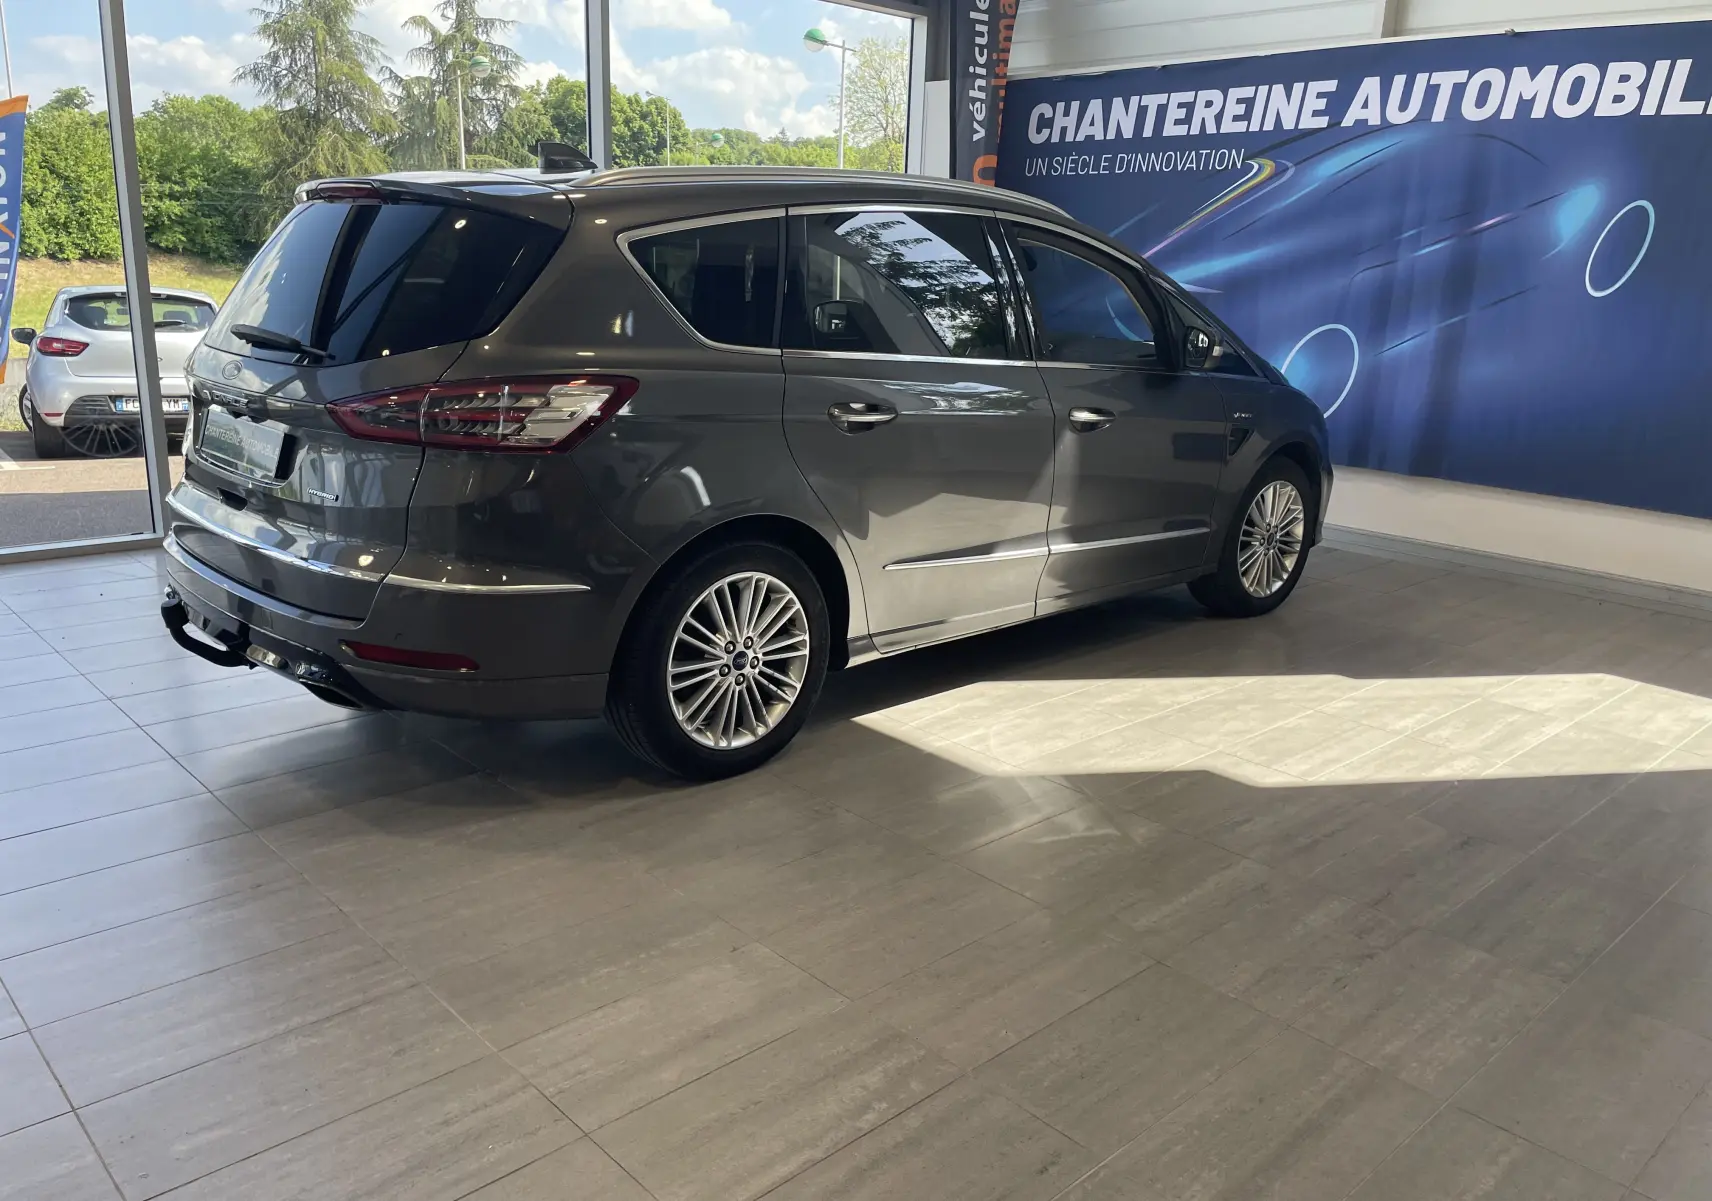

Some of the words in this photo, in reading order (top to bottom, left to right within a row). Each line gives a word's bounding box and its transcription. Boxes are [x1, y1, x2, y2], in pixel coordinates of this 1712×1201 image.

[1027, 79, 1338, 145] CHANTEREINE
[1340, 58, 1712, 127] AUTOMOBIL
[1025, 157, 1048, 177] UN
[1051, 151, 1112, 176] SIÈCLE
[1115, 148, 1245, 174] D'INNOVATION
